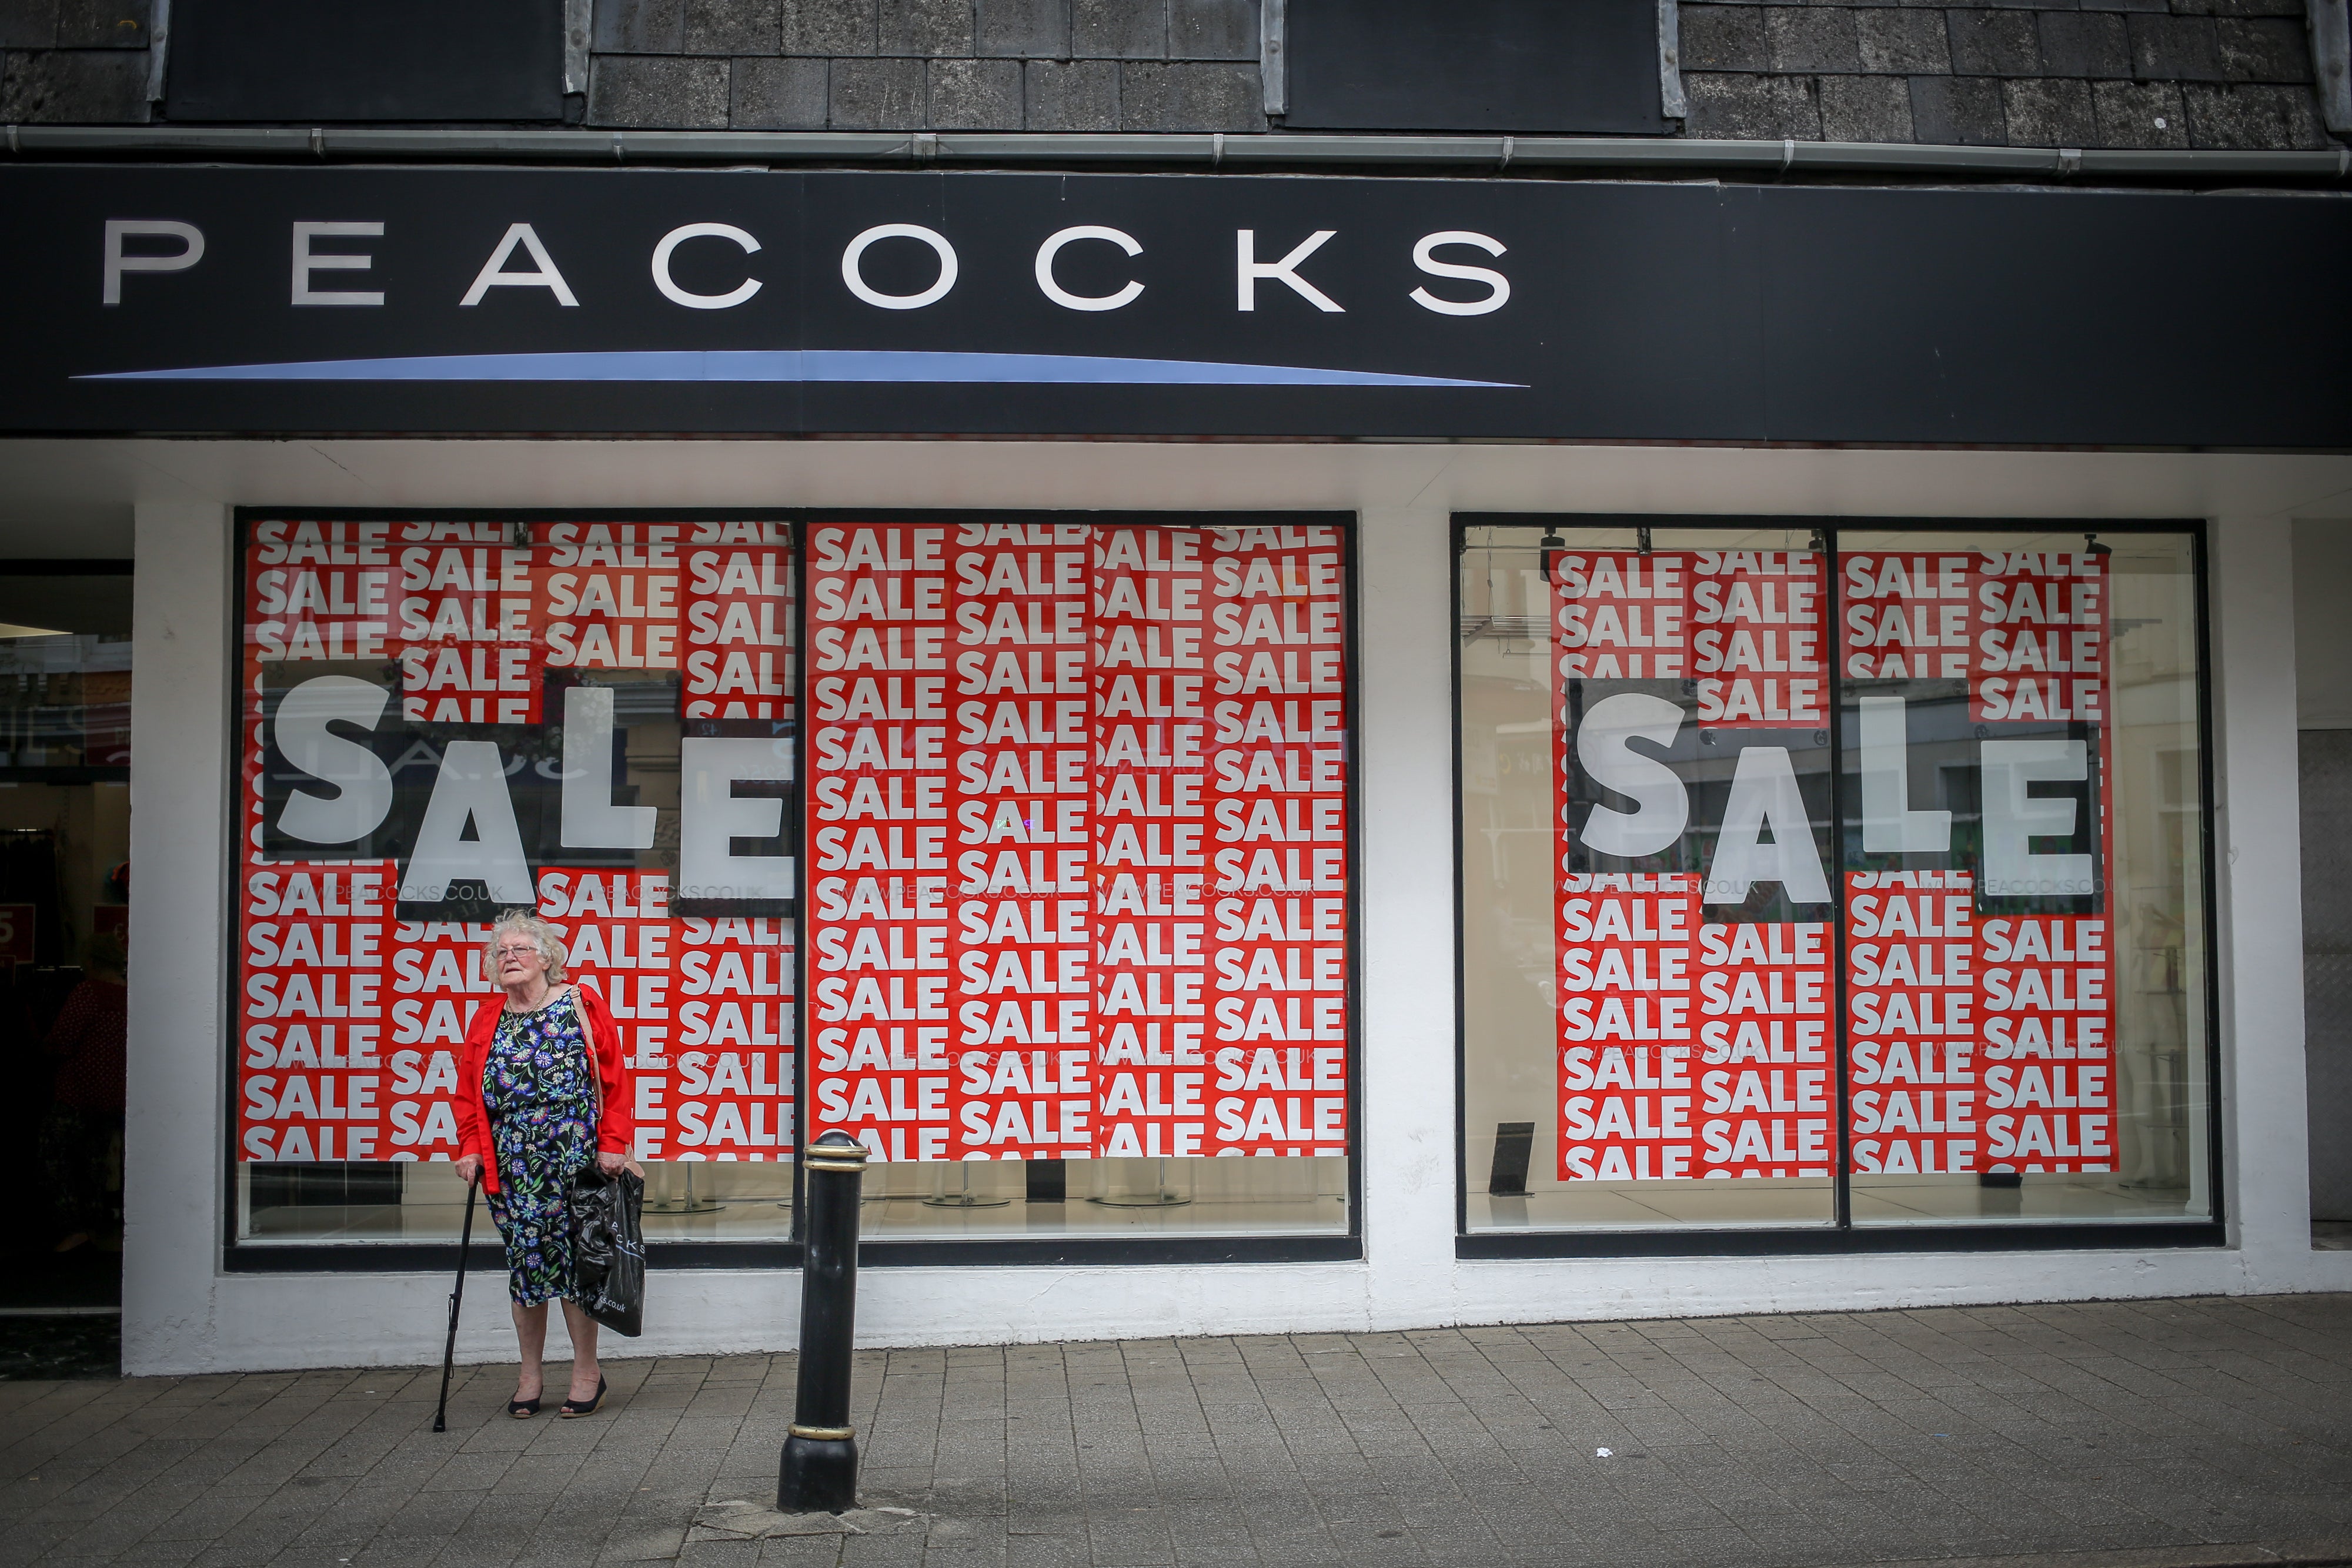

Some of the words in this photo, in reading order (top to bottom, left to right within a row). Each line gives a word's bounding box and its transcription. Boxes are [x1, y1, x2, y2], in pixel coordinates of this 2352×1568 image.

[101, 219, 1512, 316] PEACOCKS
[258, 521, 389, 564] SALE
[549, 524, 679, 568] SALE
[815, 528, 945, 571] SALE
[1094, 527, 1202, 571] ALE
[400, 547, 532, 591] SALE
[690, 551, 791, 597] SAL
[956, 553, 1085, 596] SALE
[1212, 553, 1339, 598] SALE
[1558, 557, 1683, 599] SALE
[1846, 556, 1969, 599] SALE
[257, 569, 390, 617] SALE
[547, 573, 678, 618] SALE
[815, 577, 945, 621] SALE
[1094, 576, 1202, 620] ALE
[1693, 581, 1818, 624] SALE
[1979, 581, 2100, 624] SALE
[399, 597, 531, 641] SALE
[689, 601, 792, 646] SAL
[956, 602, 1086, 646] SALE
[1213, 602, 1341, 646] SALE
[1558, 605, 1684, 648] SALE
[1847, 604, 1970, 647] SALE
[256, 620, 387, 663] SALE
[546, 622, 677, 668] SALE
[816, 627, 946, 671] SALE
[1095, 626, 1204, 668] ALE
[1694, 630, 1819, 672] SALE
[1979, 629, 2101, 671] SALE
[399, 647, 530, 691] SALE
[687, 650, 792, 696] SAL
[957, 651, 1087, 695] SALE
[1214, 651, 1341, 695] SALE
[816, 677, 946, 721] SALE
[1095, 675, 1204, 718] ALE
[1698, 678, 1820, 721] SALE
[1980, 677, 2102, 720] SALE
[957, 701, 1087, 744] SALE
[1214, 700, 1342, 744] SALE
[816, 727, 946, 771] SALE
[1096, 724, 1204, 767] ALE
[275, 675, 794, 904] SALE
[957, 751, 1087, 794] SALE
[1214, 749, 1342, 793] SALE
[816, 777, 947, 821] SALE
[1096, 774, 1204, 816] ALE
[1576, 693, 2093, 904] SALE
[958, 800, 1088, 844] SALE
[1215, 798, 1342, 842] SALE
[816, 827, 947, 871] SALE
[1097, 824, 1204, 866] ALE
[958, 850, 1088, 895] SALE
[1214, 848, 1343, 892] SALE
[1921, 880, 2120, 895] WWW.PEACOCKS.CO.U
[249, 871, 383, 916] SALE
[539, 872, 669, 918] SALE
[817, 877, 947, 921] SALE
[1097, 873, 1204, 915] ALE
[394, 921, 487, 942] SAL
[958, 900, 1089, 944] SALE
[1215, 898, 1343, 941] SALE
[1563, 898, 1689, 942] SALE
[1851, 894, 1973, 938] SALE
[248, 922, 382, 967] SALE
[817, 927, 948, 971] SALE
[1098, 923, 1205, 965] ALE
[1699, 922, 1825, 966] SALE
[1982, 920, 2106, 962] SALE
[393, 948, 499, 993] SAL
[959, 950, 1090, 995] SALE
[1215, 947, 1344, 991] SALE
[1563, 948, 1690, 991] SALE
[1851, 943, 1973, 987] SALE
[247, 973, 381, 1018] SALE
[589, 975, 669, 1019] LE
[817, 977, 948, 1022] SALE
[1098, 973, 1205, 1015] ALE
[1700, 971, 1825, 1015] SALE
[1983, 968, 2106, 1011] SALE
[960, 1000, 1090, 1045] SALE
[1215, 997, 1344, 1041] SALE
[1563, 997, 1690, 1041] SALE
[1852, 992, 1974, 1035] SALE
[246, 1024, 380, 1069] SALE
[817, 1027, 949, 1072] SALE
[1099, 1023, 1205, 1065] ALE
[1700, 1021, 1826, 1064] SALE
[1984, 1017, 2107, 1059] SALE
[274, 1054, 463, 1070] WWW.PEACOCKS.C
[391, 1050, 458, 1095] SA
[623, 1053, 763, 1068] COCKS.CO.UK
[960, 1050, 1091, 1095] SALE
[1215, 1047, 1344, 1091] SALE
[1564, 1047, 1691, 1091] SALE
[1852, 1041, 1975, 1084] SALE
[245, 1075, 379, 1120] SALE
[818, 1077, 950, 1122] SALE
[1100, 1073, 1205, 1115] ALE
[1702, 1069, 1826, 1114] SALE
[1984, 1065, 2108, 1109] SALE
[390, 1101, 459, 1145] SA
[960, 1100, 1091, 1145] SALE
[1215, 1097, 1345, 1141] SALE
[1565, 1096, 1692, 1140] SALE
[1852, 1090, 1976, 1134] SALE
[244, 1126, 378, 1162] SALE
[1100, 1122, 1205, 1157] ALE
[1702, 1119, 1828, 1163] SALE
[1853, 1139, 1976, 1174] SALE
[1986, 1114, 2110, 1158] SALE
[1566, 1145, 1692, 1181] SALE
